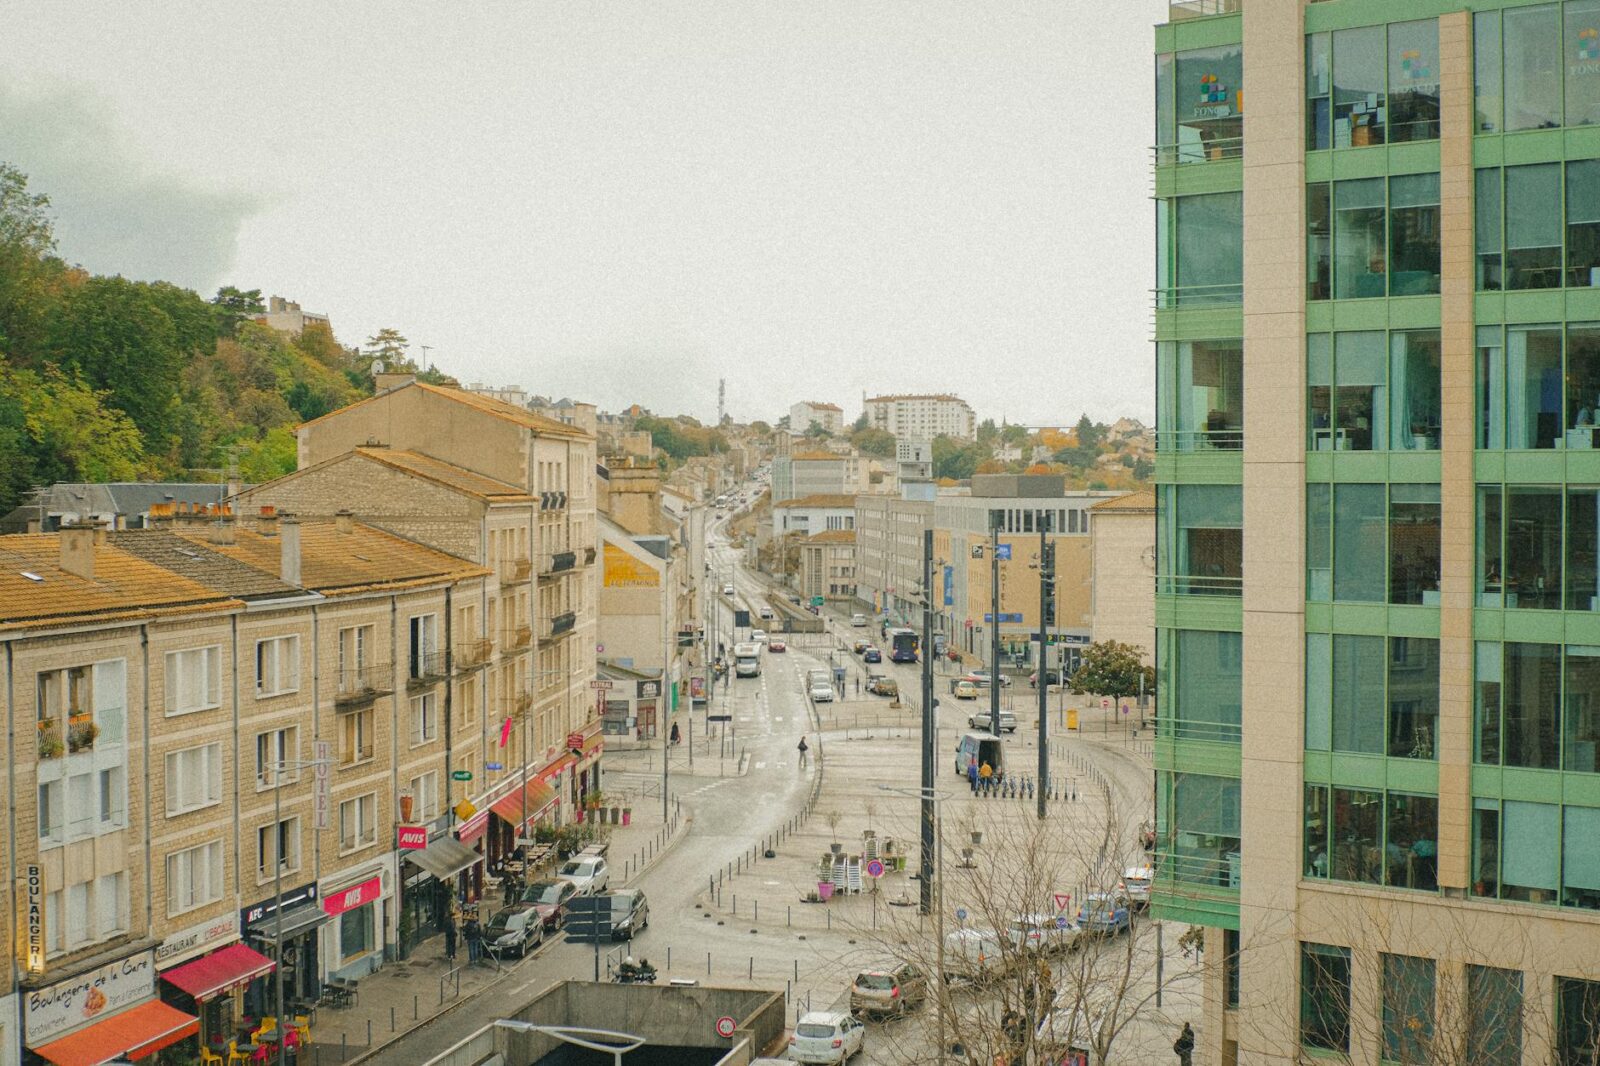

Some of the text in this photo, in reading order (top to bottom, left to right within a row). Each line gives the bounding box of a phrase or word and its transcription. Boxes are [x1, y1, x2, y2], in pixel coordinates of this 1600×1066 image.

[318, 743, 327, 828] HOTEL
[401, 832, 425, 843] AVIS
[344, 887, 362, 909] AVIS
[28, 866, 41, 975] BOULANGERIE
[157, 934, 198, 958] RESTAURANT
[30, 959, 148, 1011] Boulangerie de la Gare
